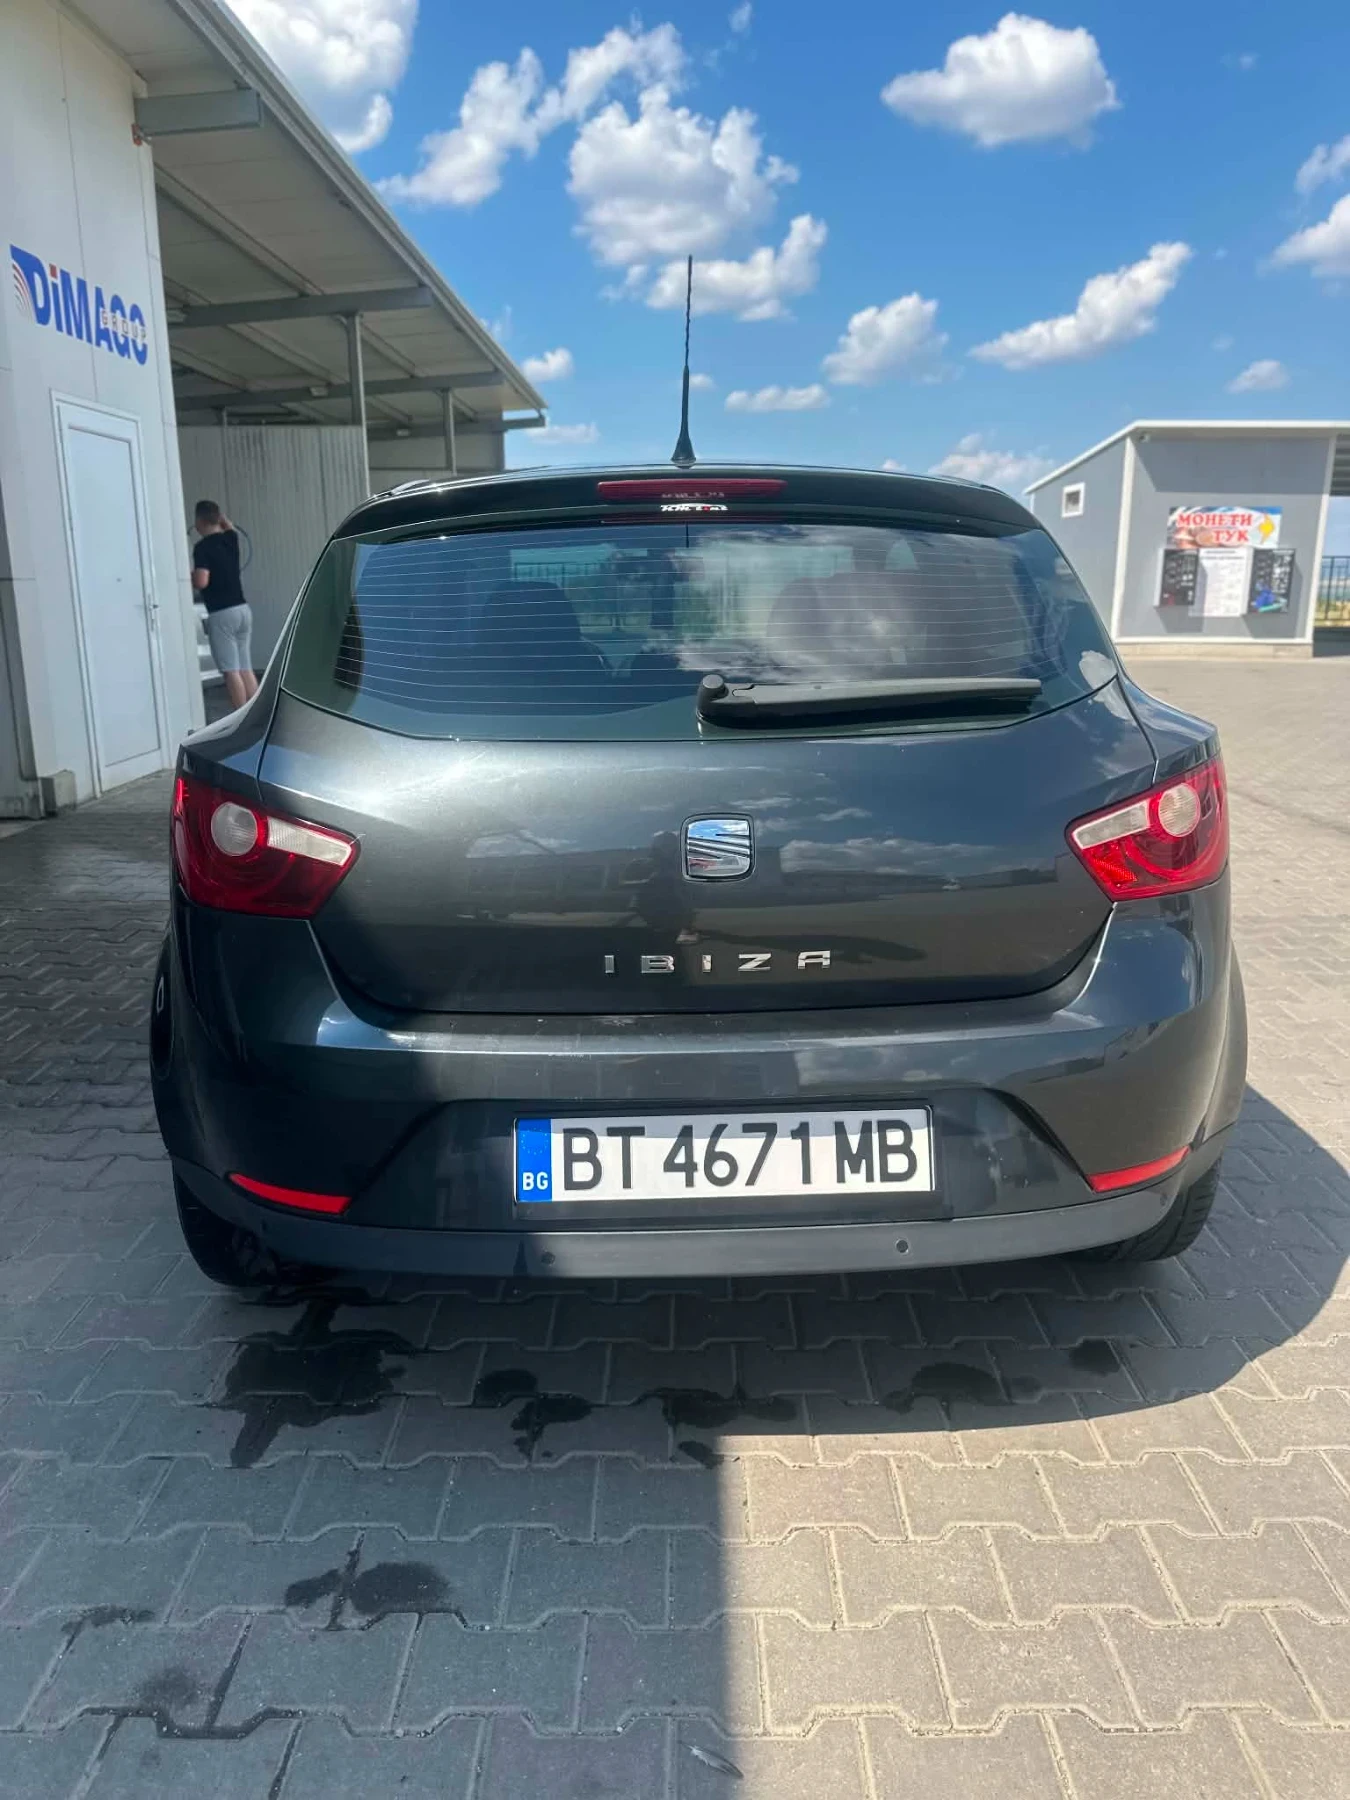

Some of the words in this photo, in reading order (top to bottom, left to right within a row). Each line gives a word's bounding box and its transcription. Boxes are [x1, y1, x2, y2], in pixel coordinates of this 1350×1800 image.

[1177, 513, 1254, 526] МОНЕТИ
[1213, 530, 1250, 542] ТУК
[604, 950, 831, 974] IBIZA
[562, 1125, 646, 1191] BT
[662, 1121, 812, 1189] 4671
[834, 1119, 918, 1184] MB
[521, 1171, 549, 1191] BG
